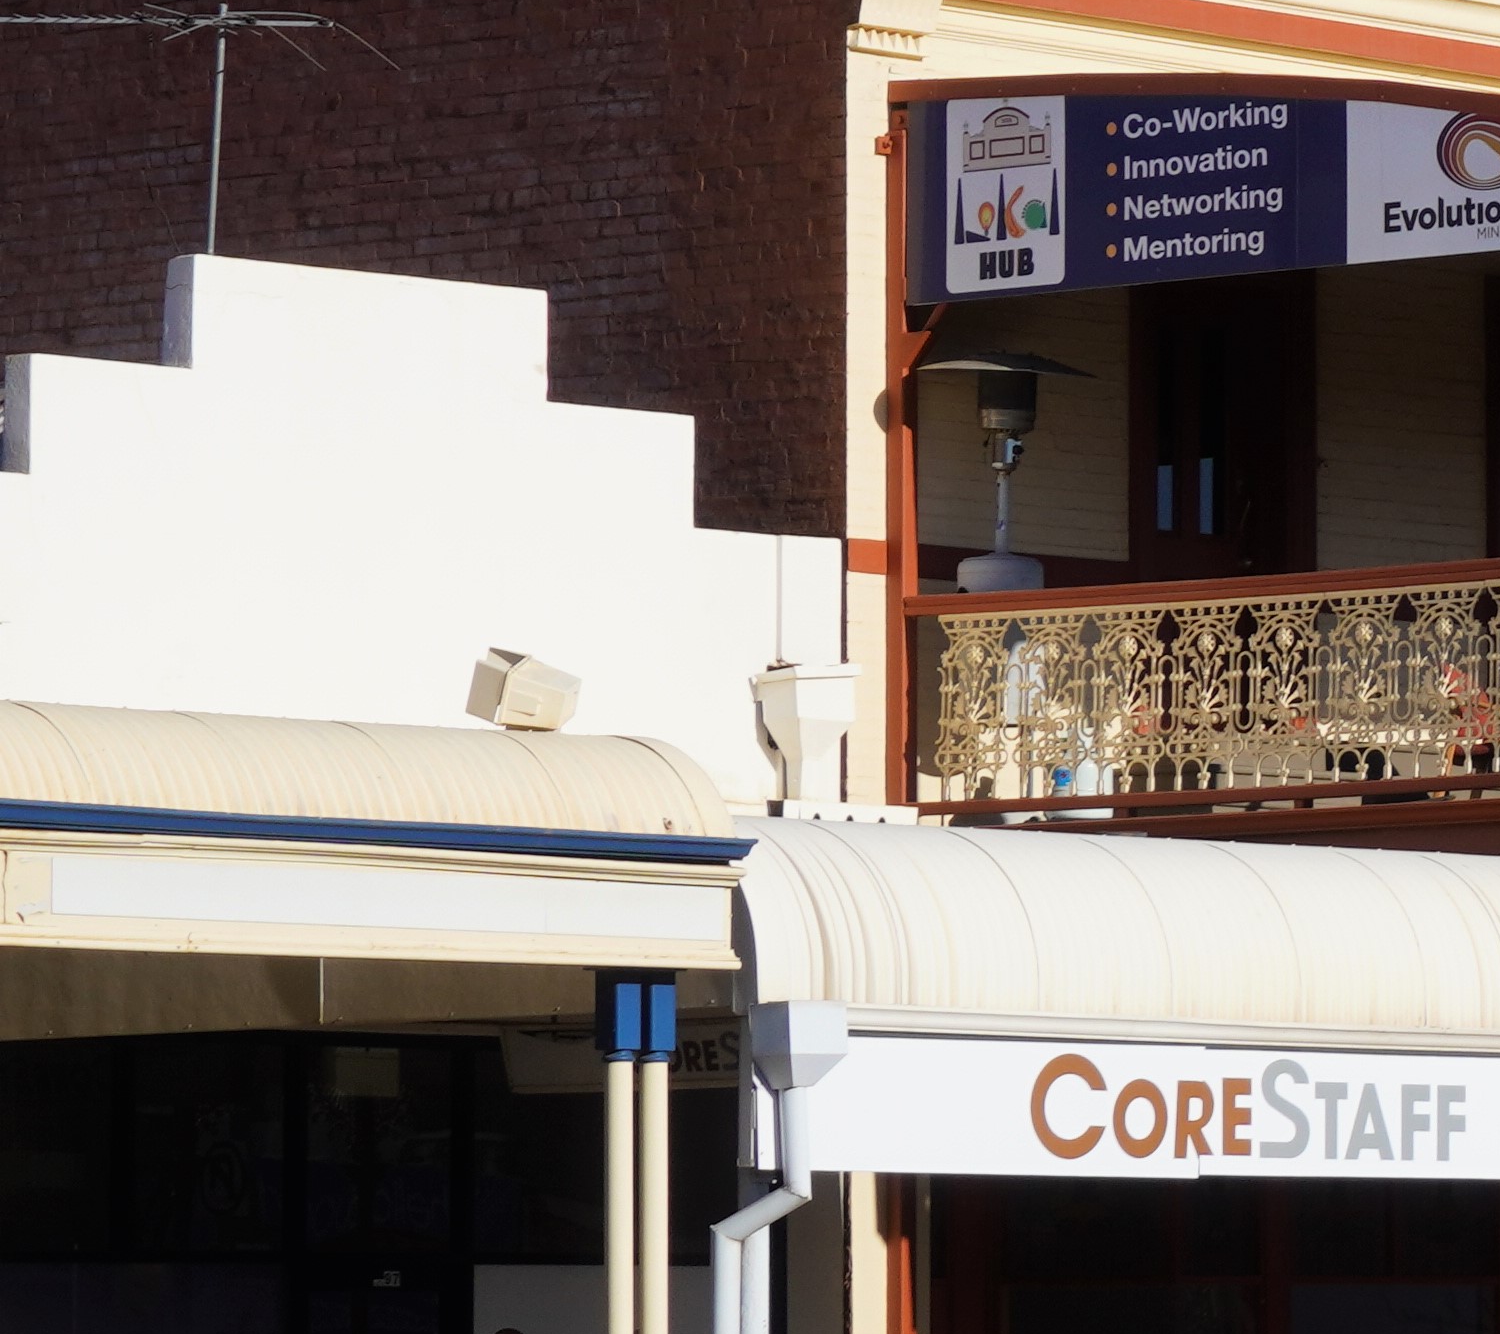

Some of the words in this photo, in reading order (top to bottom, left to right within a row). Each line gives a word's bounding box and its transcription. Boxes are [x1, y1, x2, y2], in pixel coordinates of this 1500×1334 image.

[1123, 101, 1288, 139] Co-Working
[1123, 145, 1268, 180] Innovation
[1123, 184, 1283, 221] Networking
[1123, 228, 1265, 263] Mentoring
[979, 247, 1035, 280] HUB
